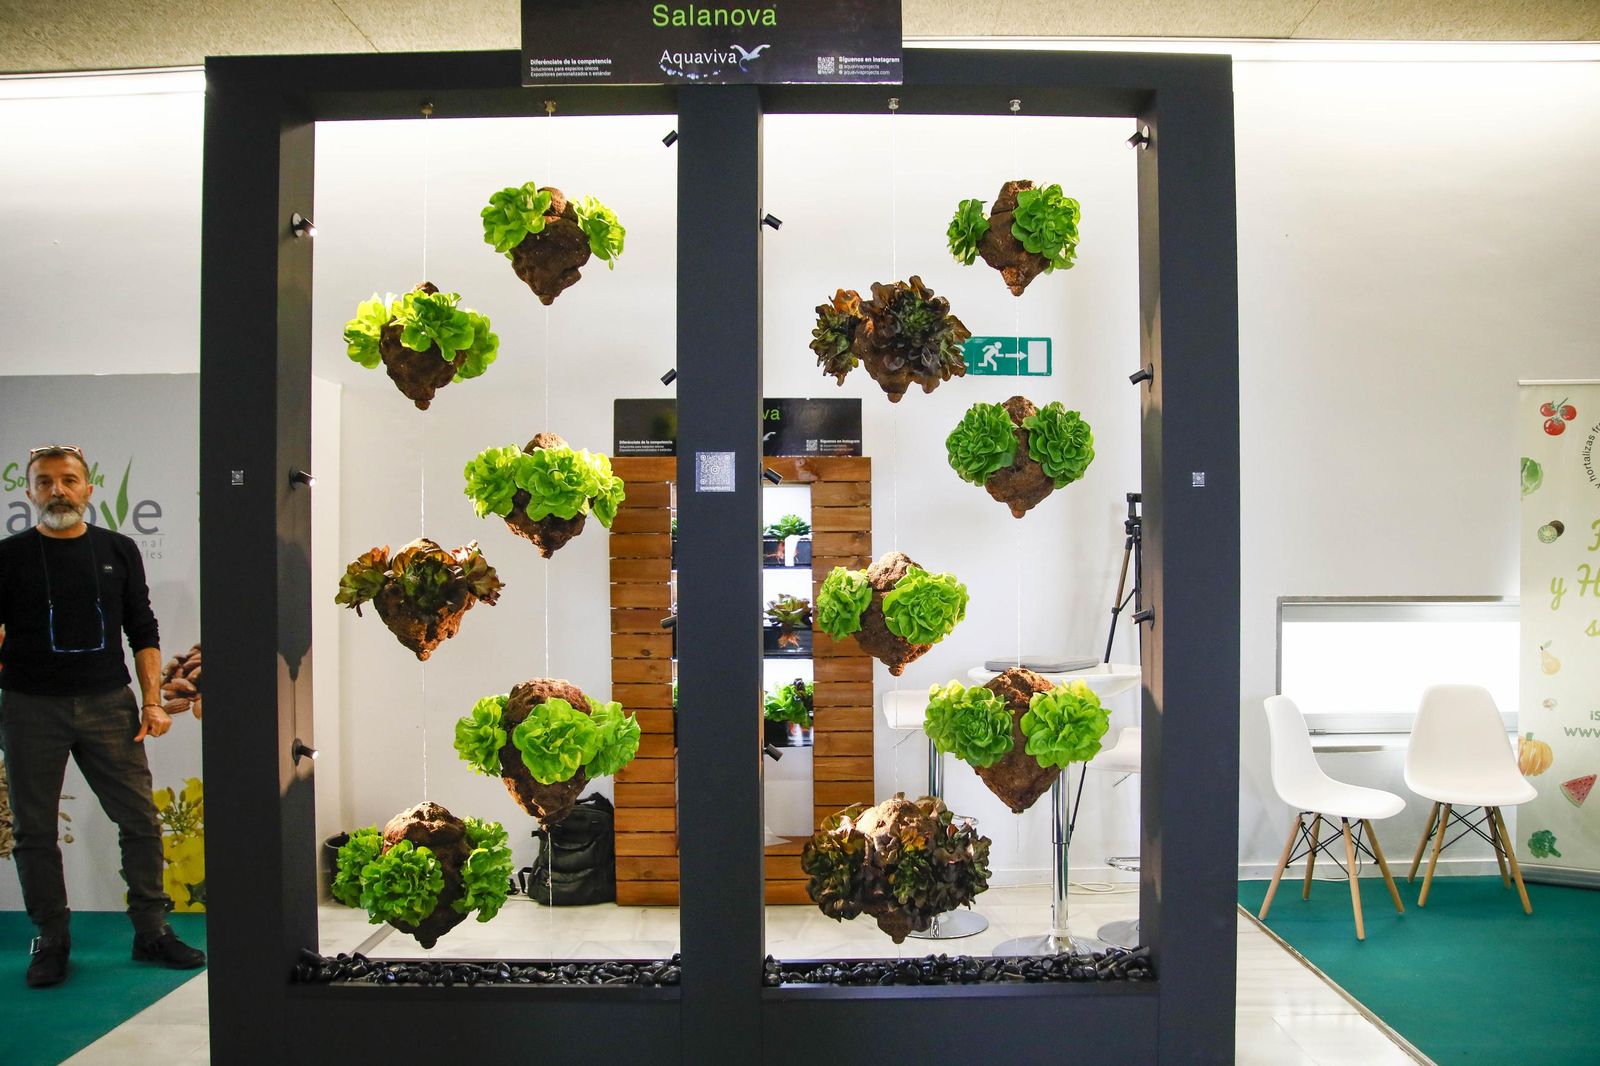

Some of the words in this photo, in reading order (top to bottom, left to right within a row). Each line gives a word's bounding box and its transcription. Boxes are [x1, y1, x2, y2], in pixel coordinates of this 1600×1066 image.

[652, 4, 777, 27] Salanova
[577, 58, 612, 66] competencia
[660, 49, 737, 69] Aquaviva
[872, 56, 900, 64] Instagram
[1582, 434, 1597, 483] hortalizas
